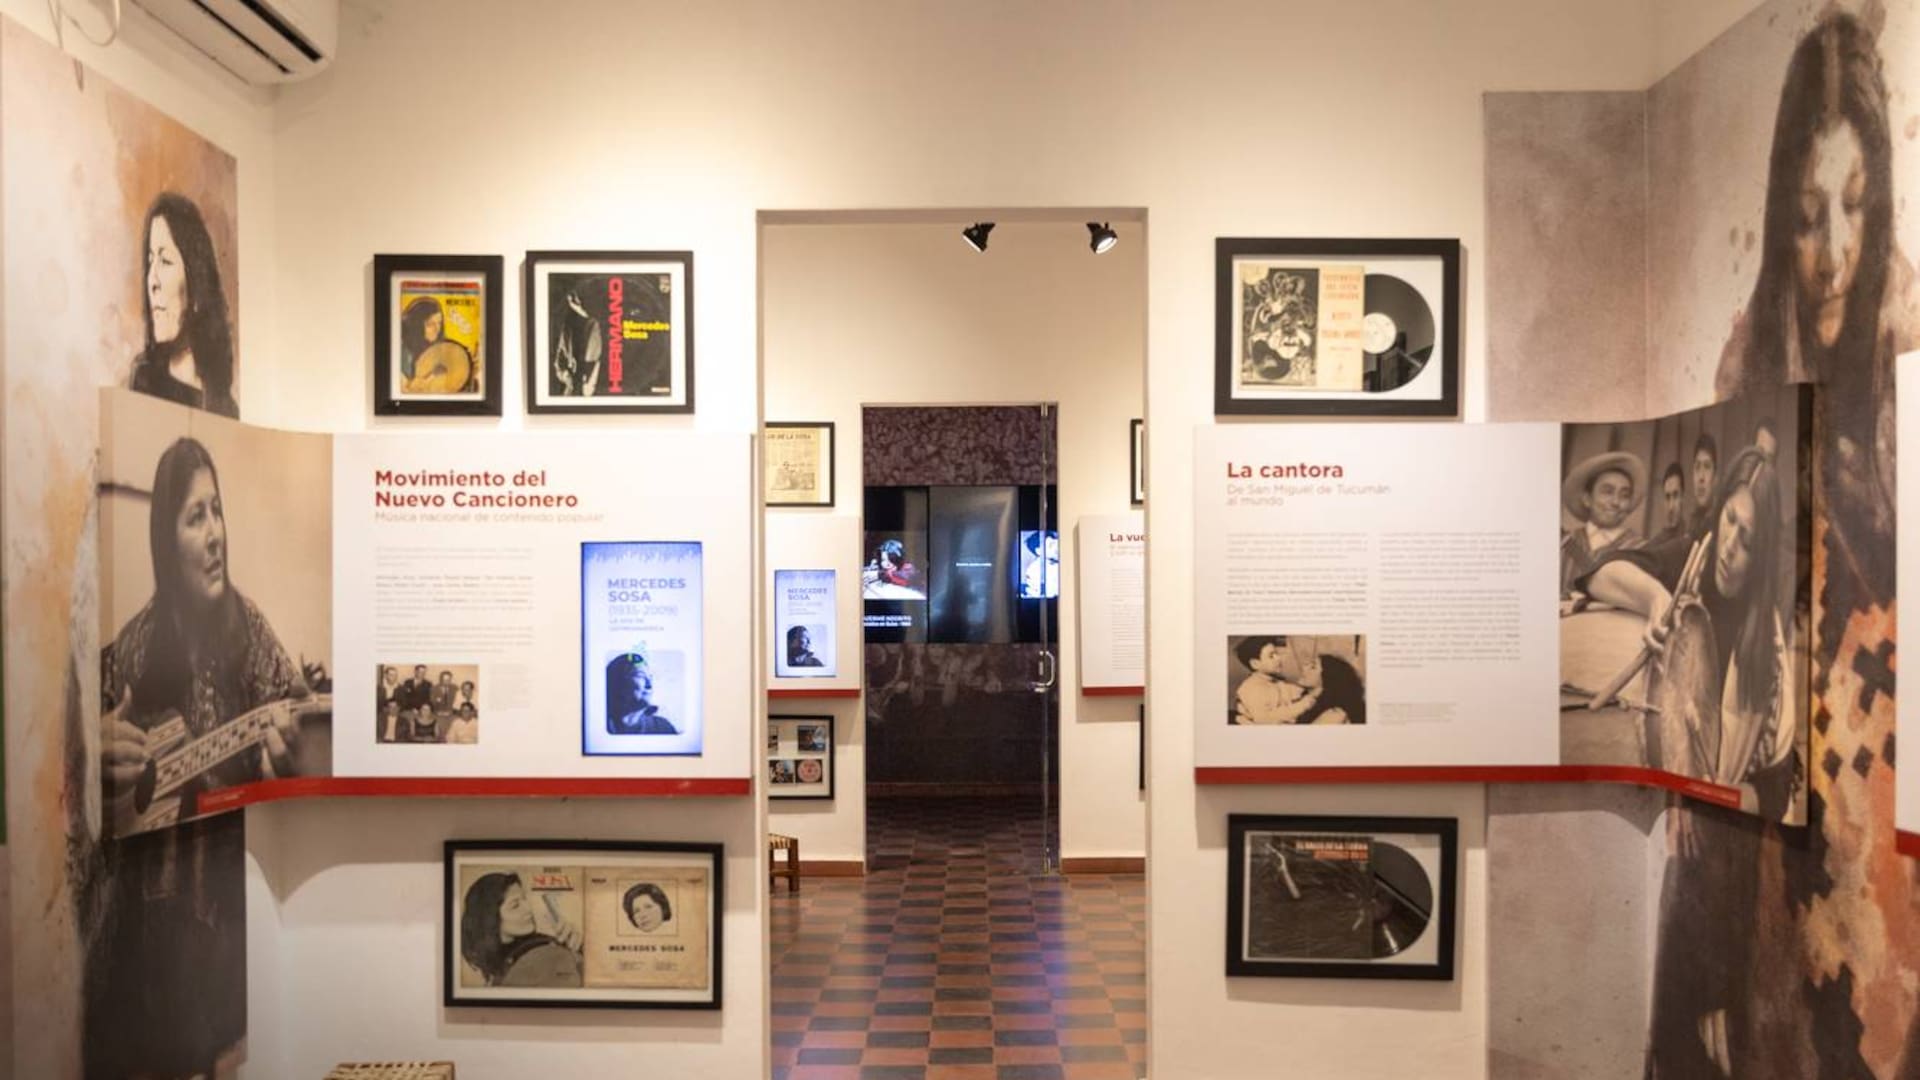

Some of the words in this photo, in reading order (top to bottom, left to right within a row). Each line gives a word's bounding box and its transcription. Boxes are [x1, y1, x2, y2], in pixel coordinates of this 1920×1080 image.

[622, 320, 670, 332] Mercedes
[608, 277, 624, 393] HERMANO
[622, 330, 649, 340] Sosa
[1227, 462, 1253, 478] La
[1259, 463, 1344, 478] cantora
[375, 470, 505, 487] Movimiento
[512, 470, 546, 487] del
[1227, 484, 1243, 495] De
[1248, 484, 1270, 495] San
[1274, 484, 1313, 498] Miguel
[1316, 484, 1332, 495] de
[1336, 483, 1391, 495] Tucumán
[375, 491, 446, 508] Nuevo
[453, 490, 579, 508] Cancionero
[1226, 495, 1237, 506] al
[1241, 495, 1285, 506] mundo
[375, 511, 417, 523] Música
[419, 511, 468, 523] nacional
[474, 511, 489, 523] de
[492, 511, 555, 523] contenido
[557, 512, 605, 525] popular
[1110, 533, 1123, 542] La
[607, 577, 687, 590] MERCEDES
[607, 590, 652, 603] SOSA
[608, 944, 657, 953] MERCEDES
[660, 944, 686, 953] SOSA
